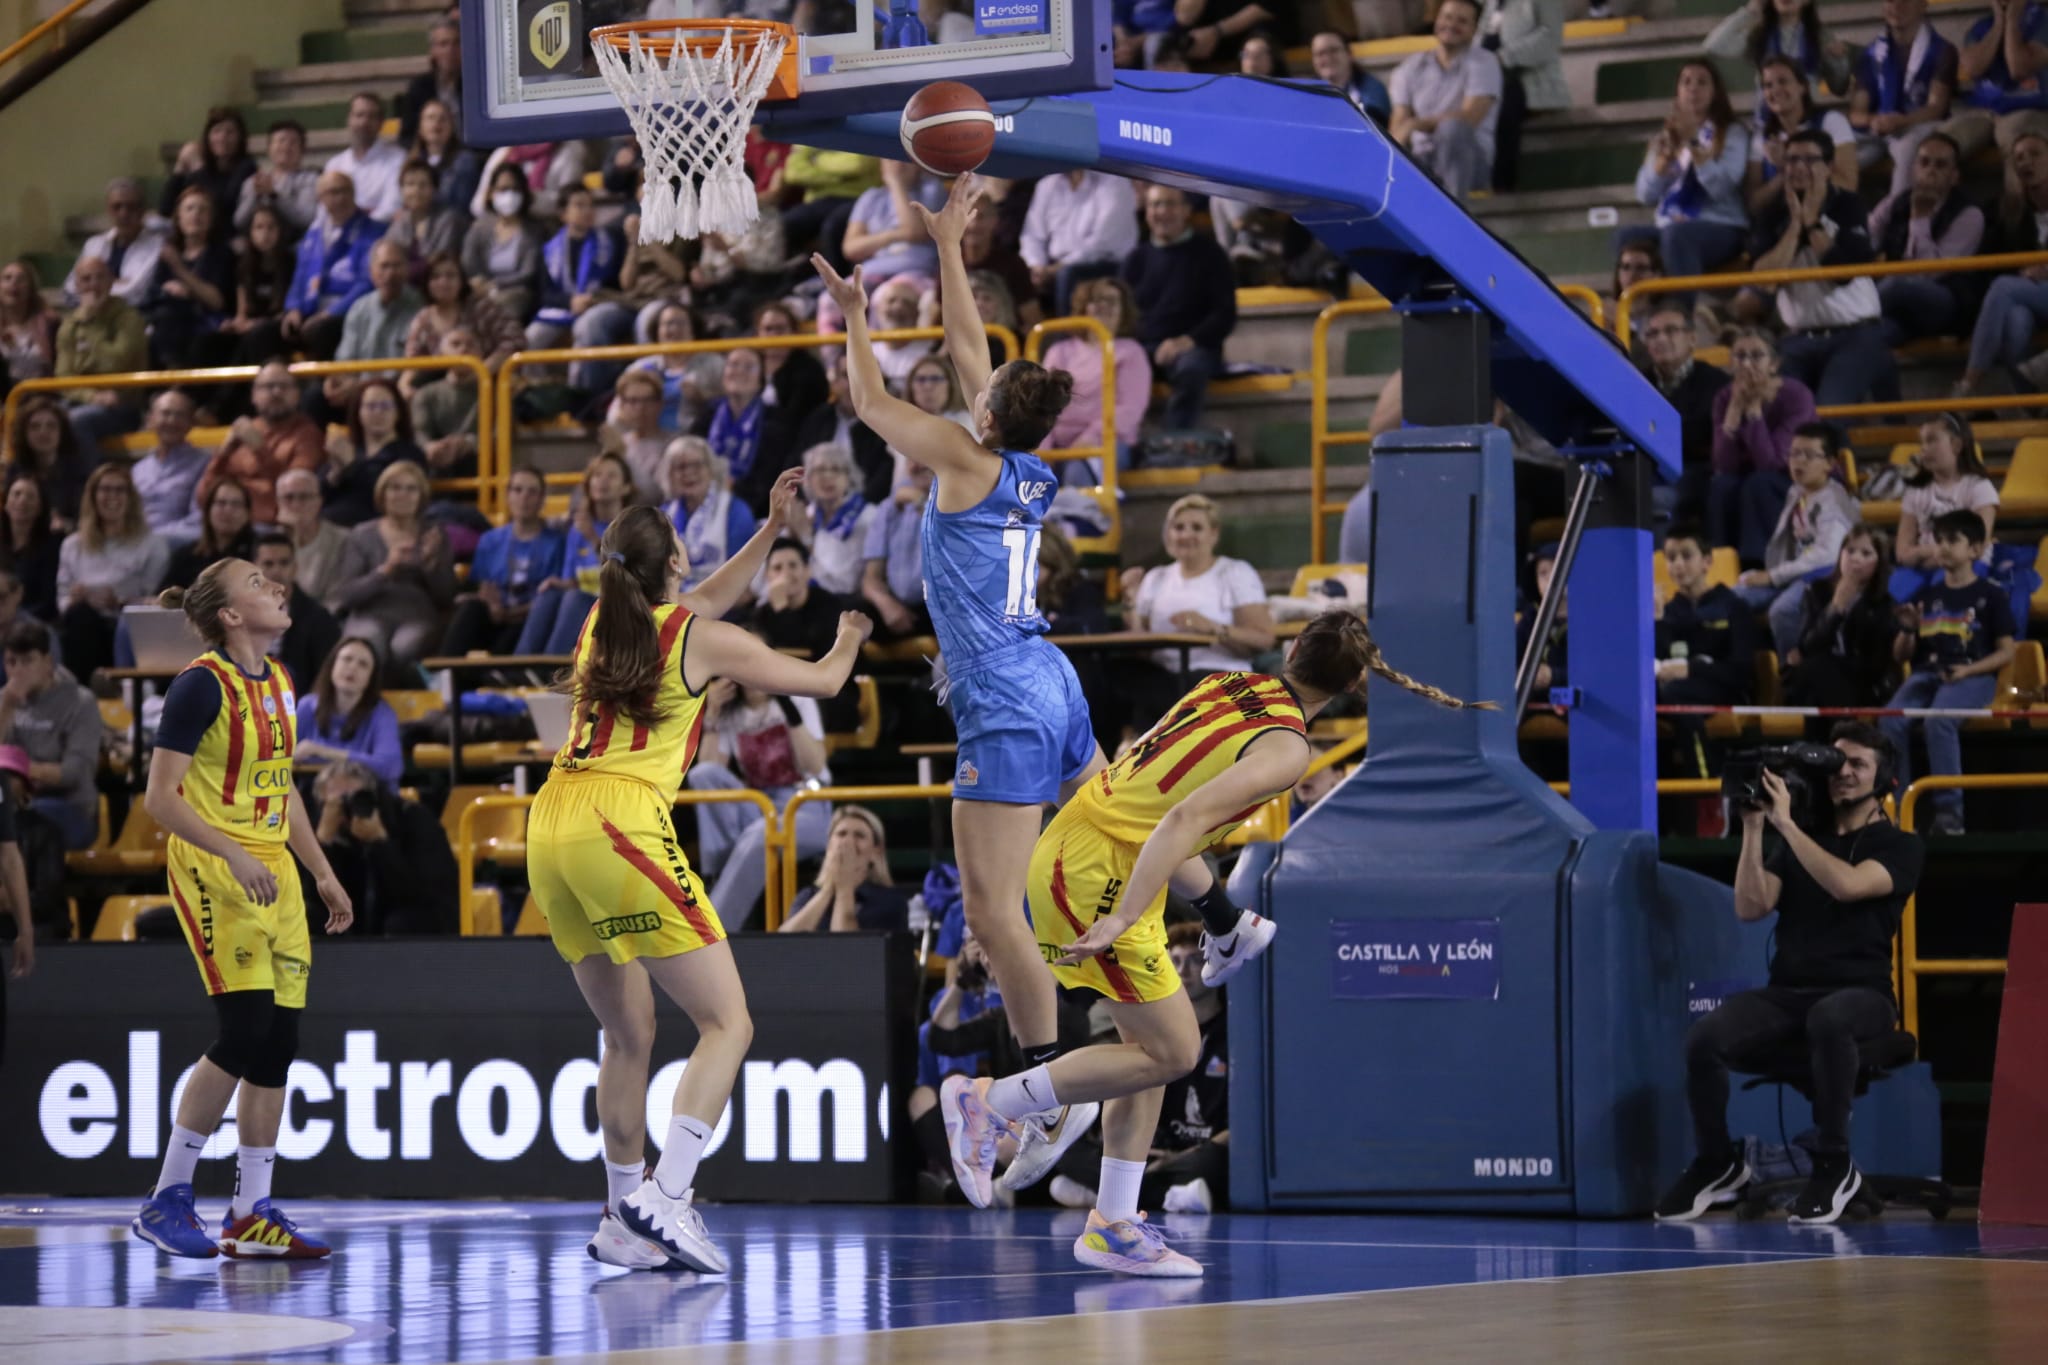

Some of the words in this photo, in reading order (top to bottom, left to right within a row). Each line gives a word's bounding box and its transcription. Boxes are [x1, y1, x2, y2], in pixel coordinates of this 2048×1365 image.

[980, 6, 996, 17] LF
[996, 4, 1039, 16] endesa
[1119, 119, 1172, 147] MONDO
[269, 719, 285, 751] 23
[1338, 943, 1420, 961] CASTILLA
[1428, 943, 1441, 964] Y
[1447, 938, 1493, 961] LEÓN
[1474, 1158, 1553, 1177] MONDO
